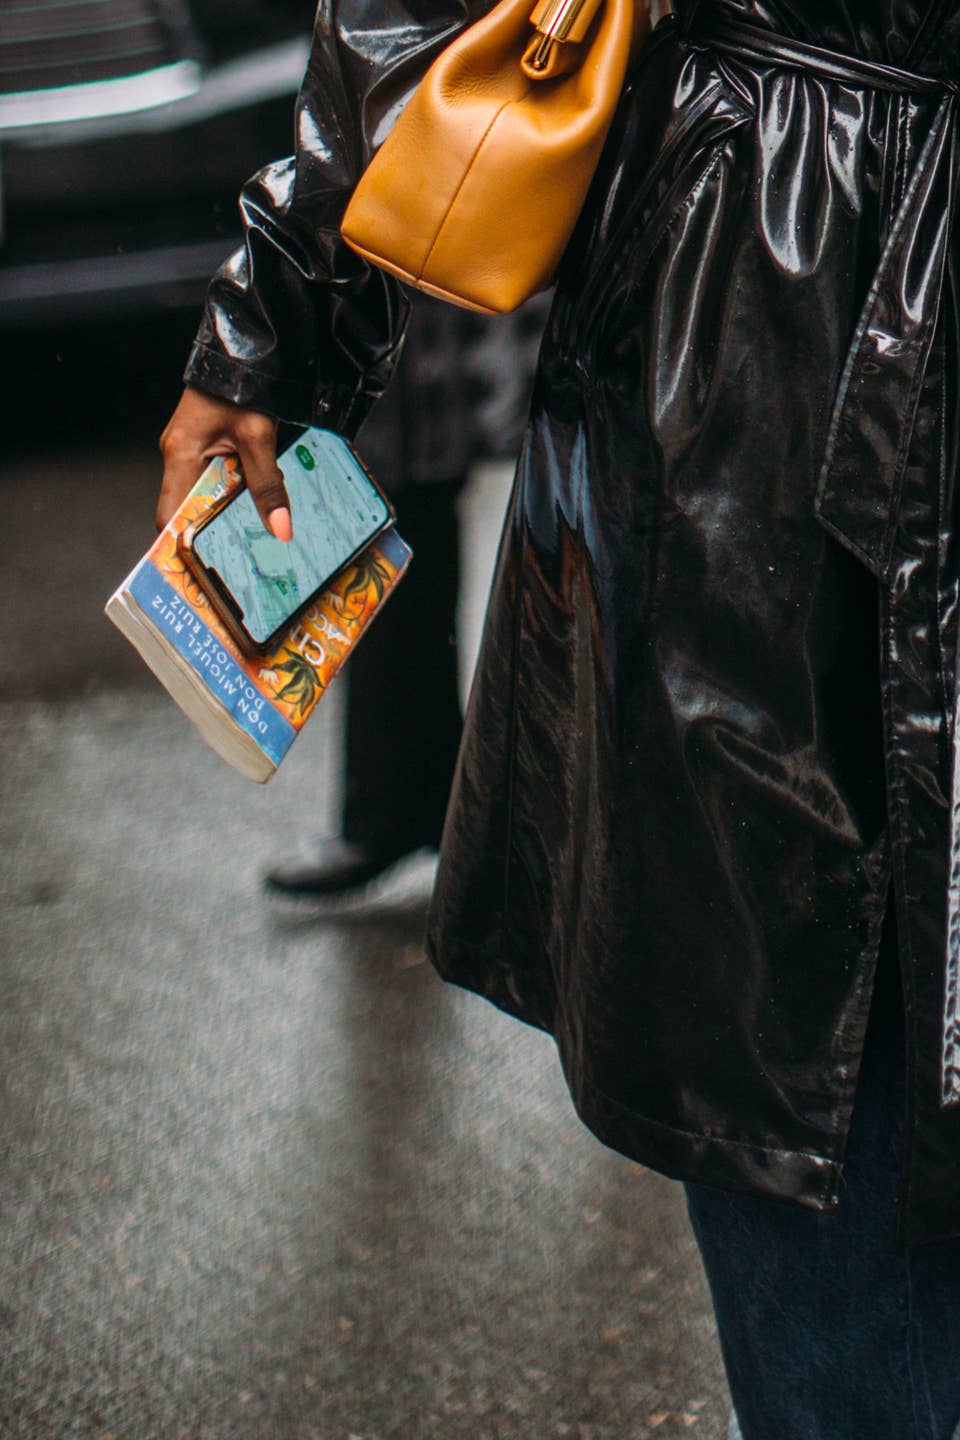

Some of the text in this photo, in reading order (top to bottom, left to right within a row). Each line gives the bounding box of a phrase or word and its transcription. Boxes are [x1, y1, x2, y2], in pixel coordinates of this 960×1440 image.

[151, 595, 184, 634] RUIZ
[169, 595, 202, 634] RUIZ
[188, 633, 237, 696] MIGUEL
[235, 674, 265, 711] DON
[237, 698, 269, 734] DON
